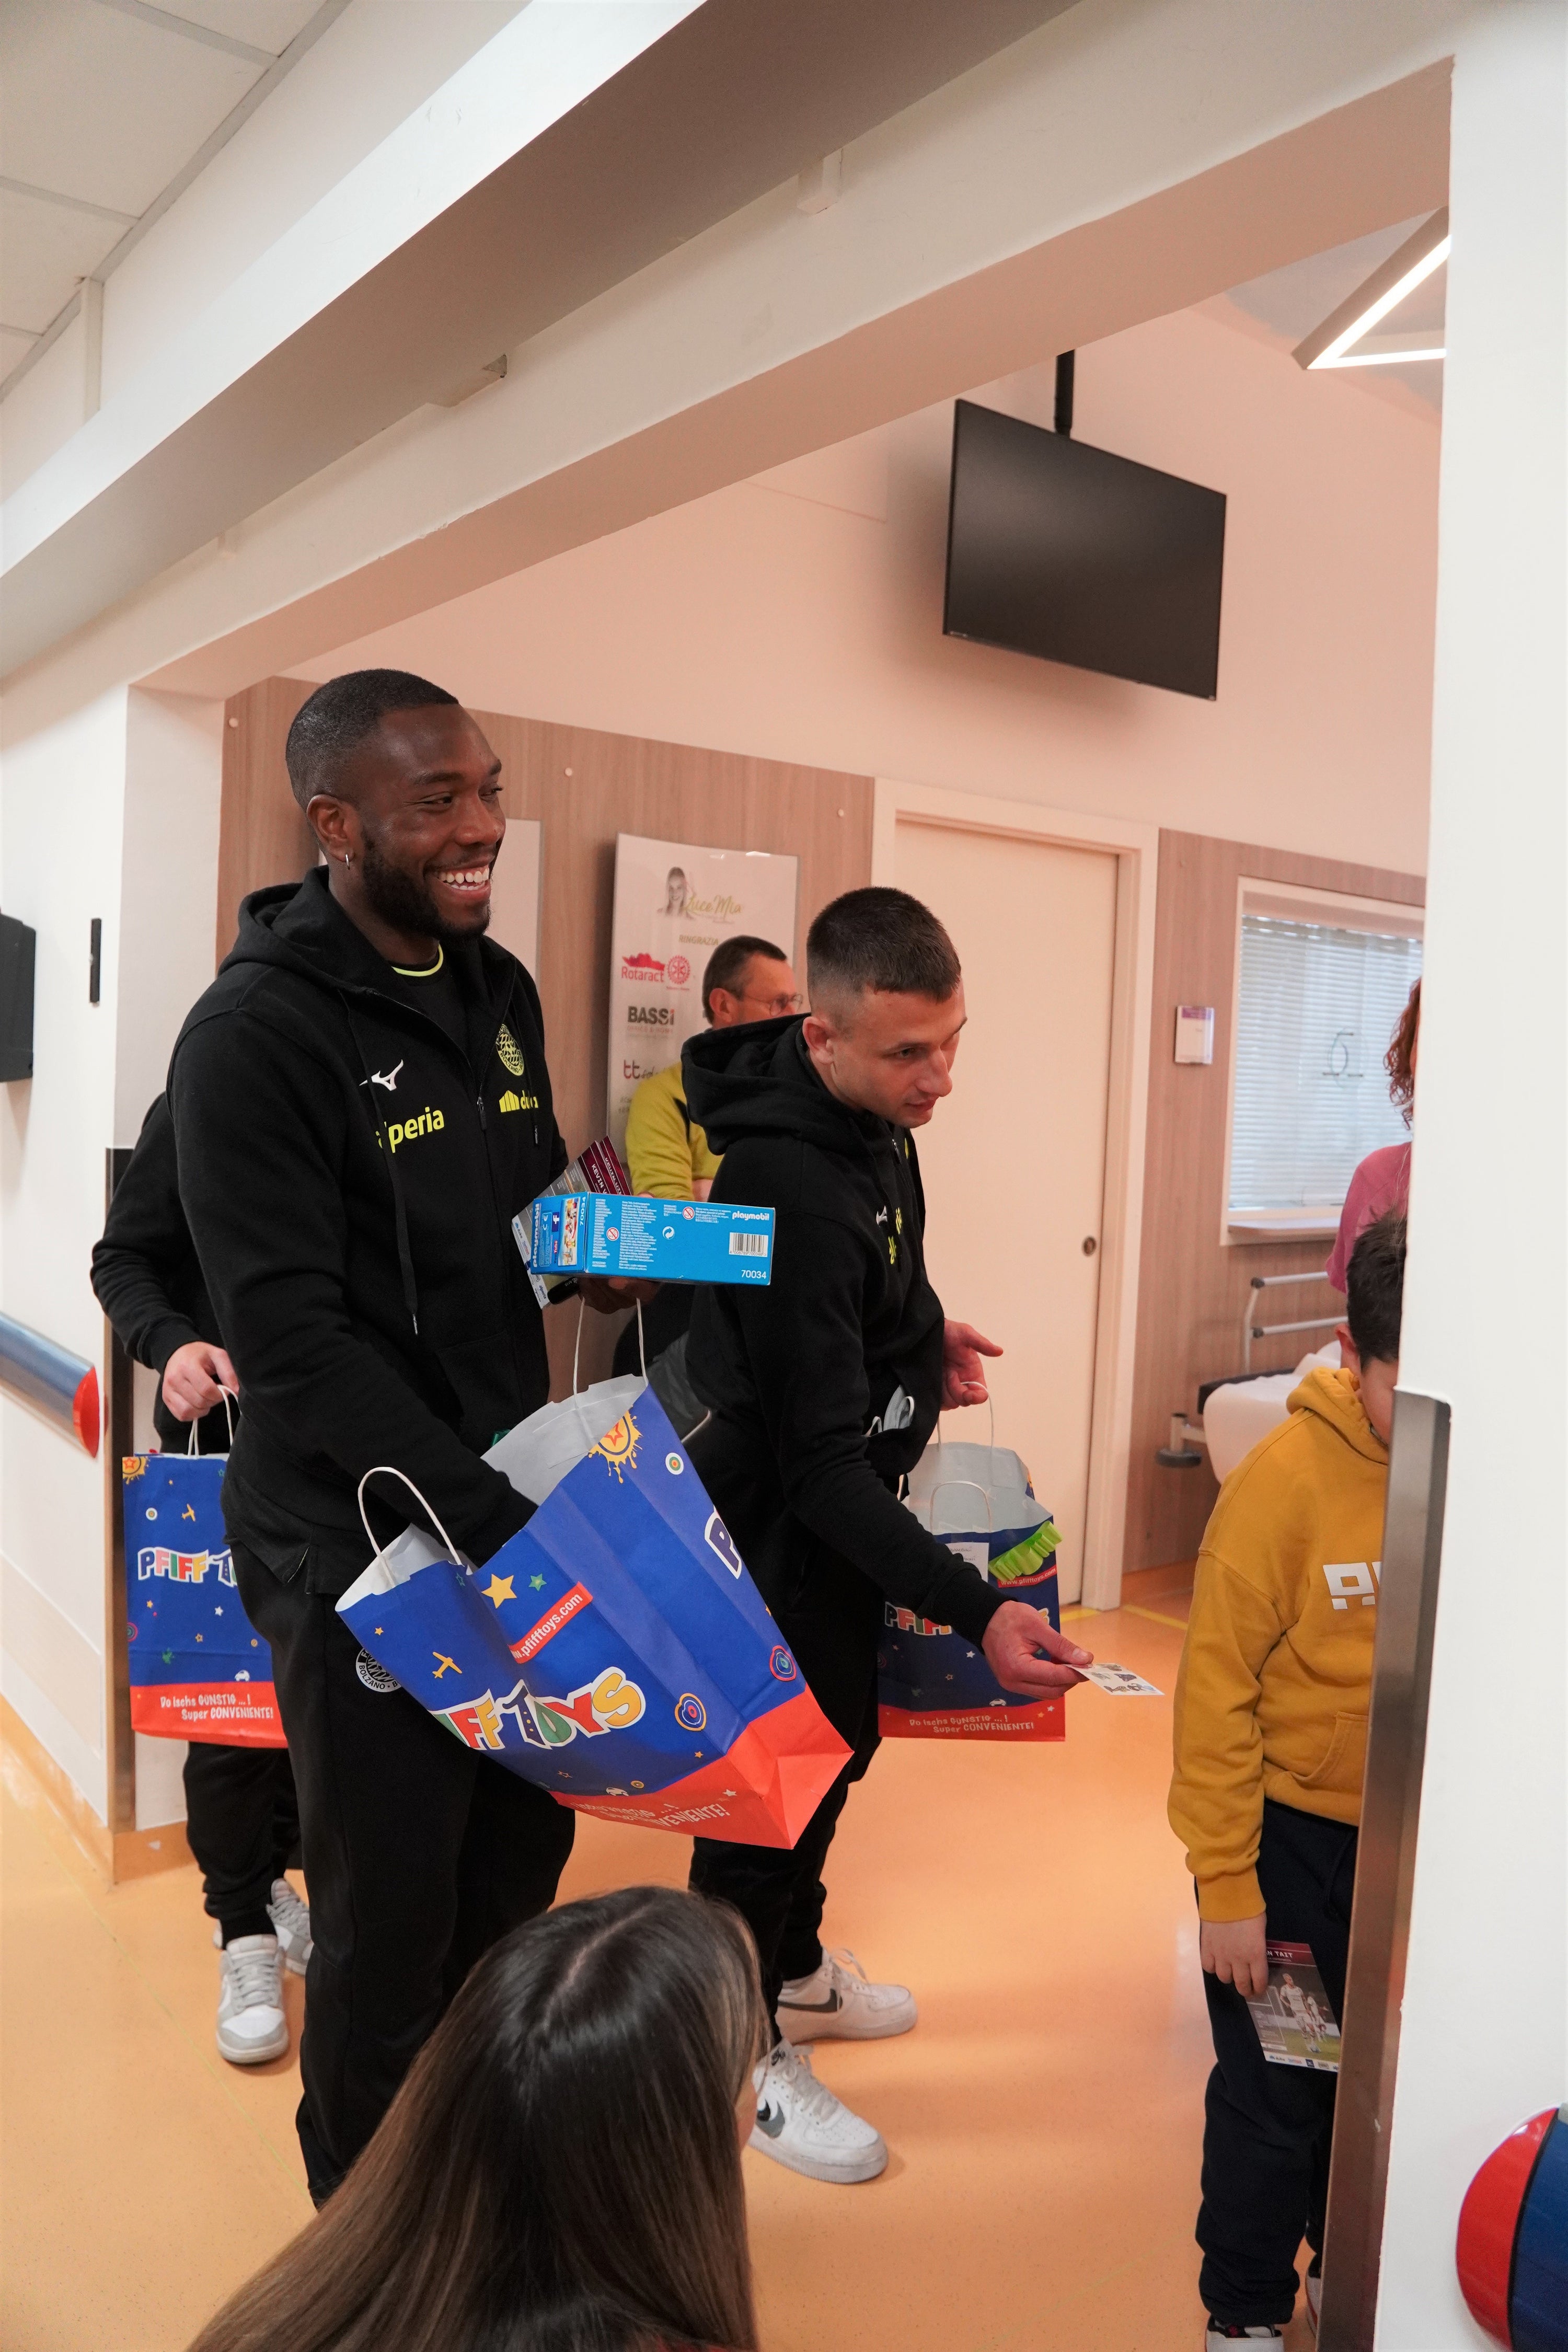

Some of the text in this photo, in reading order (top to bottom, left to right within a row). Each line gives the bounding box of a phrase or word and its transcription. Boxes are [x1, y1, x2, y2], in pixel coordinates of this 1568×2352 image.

[679, 935, 719, 946] RINGRAZIA
[621, 966, 664, 983] Rotaract
[500, 1053, 520, 1074] BOLZANO
[591, 1163, 605, 1189] KEVIN
[732, 1210, 770, 1221] playmobil
[741, 1270, 767, 1279] 70034
[137, 1547, 209, 1584] PFIFF
[510, 1594, 583, 1658] w.pfifftoys.com
[359, 1665, 386, 1690] BOLZANO
[160, 1696, 171, 1708] Do
[181, 1707, 273, 1722] Super CONVENIENTE!
[963, 1722, 1034, 1732] CONVENIENTE!
